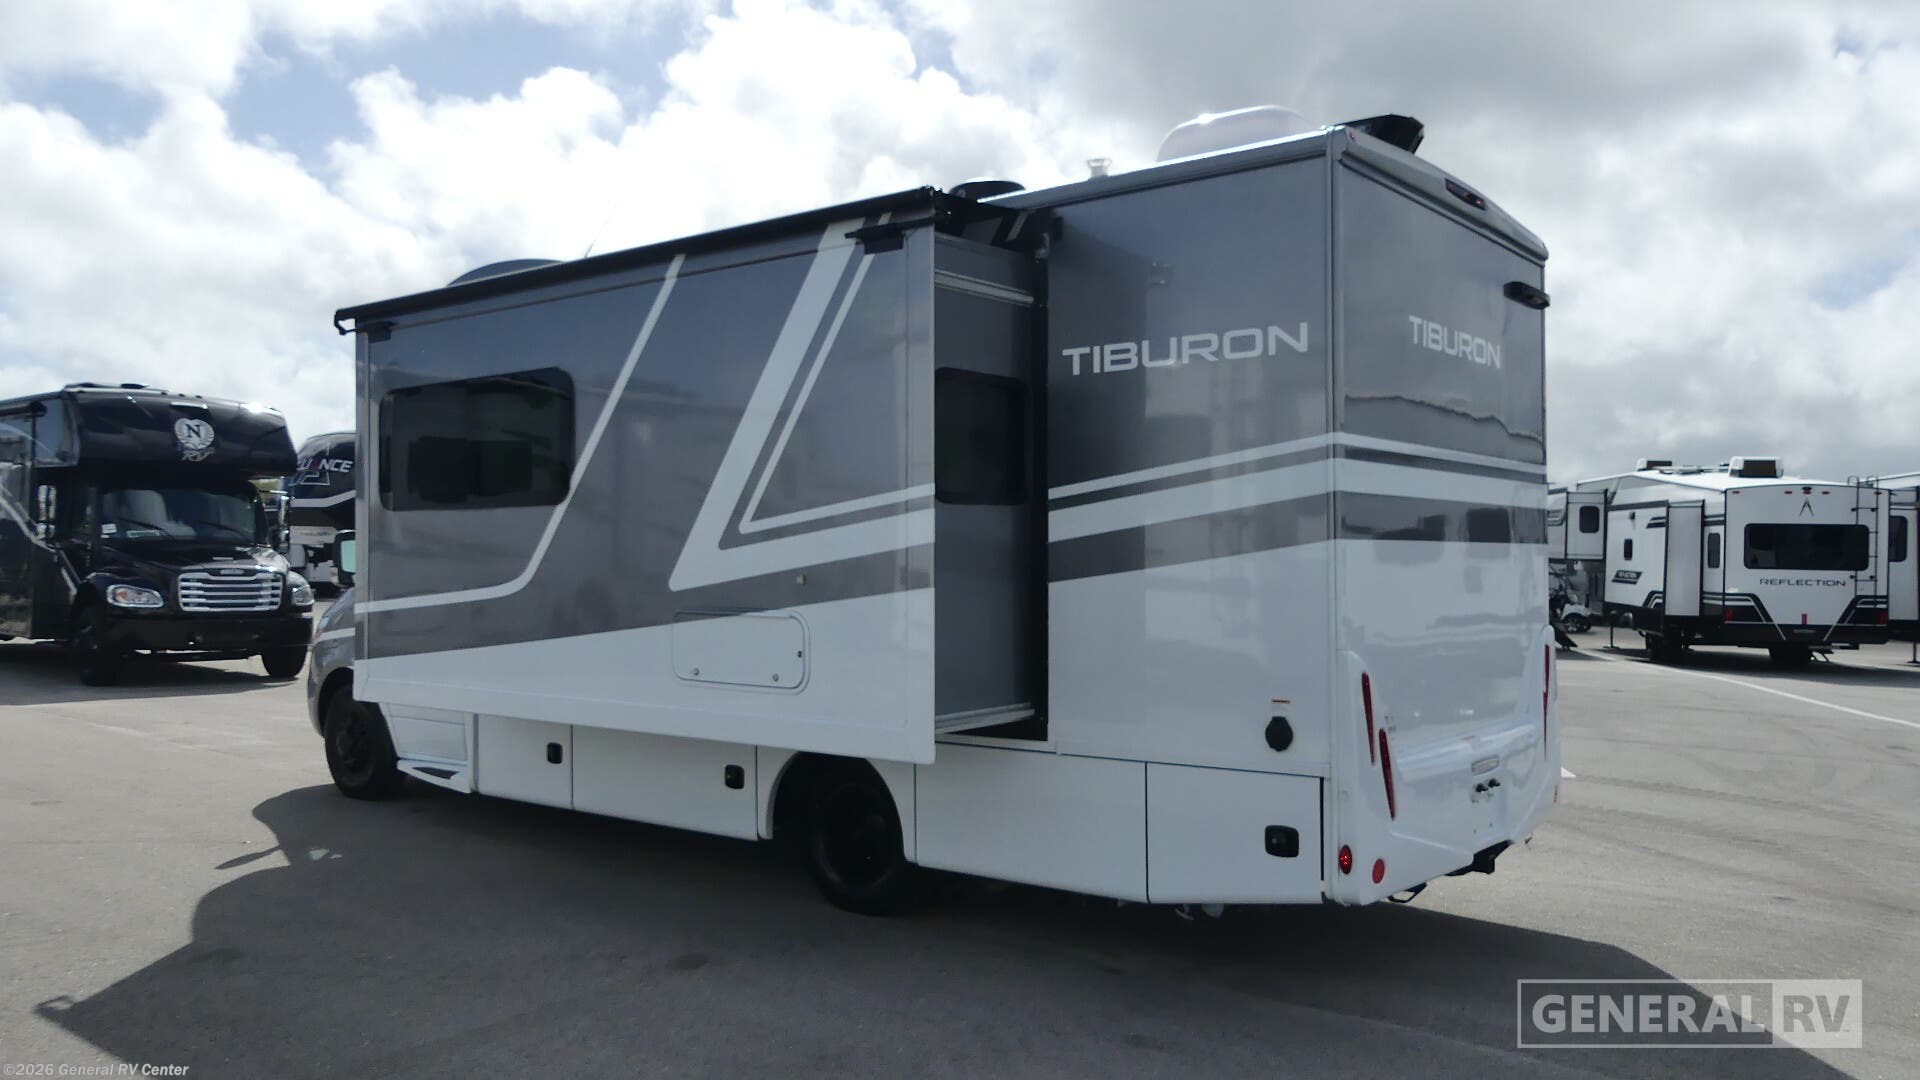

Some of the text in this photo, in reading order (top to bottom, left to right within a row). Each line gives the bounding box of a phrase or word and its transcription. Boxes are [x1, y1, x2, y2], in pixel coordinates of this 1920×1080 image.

[1062, 322, 1308, 375] TIBURON
[1409, 315, 1500, 369] TIBURON
[185, 423, 202, 439] N
[1759, 578, 1846, 586] REFLECTION
